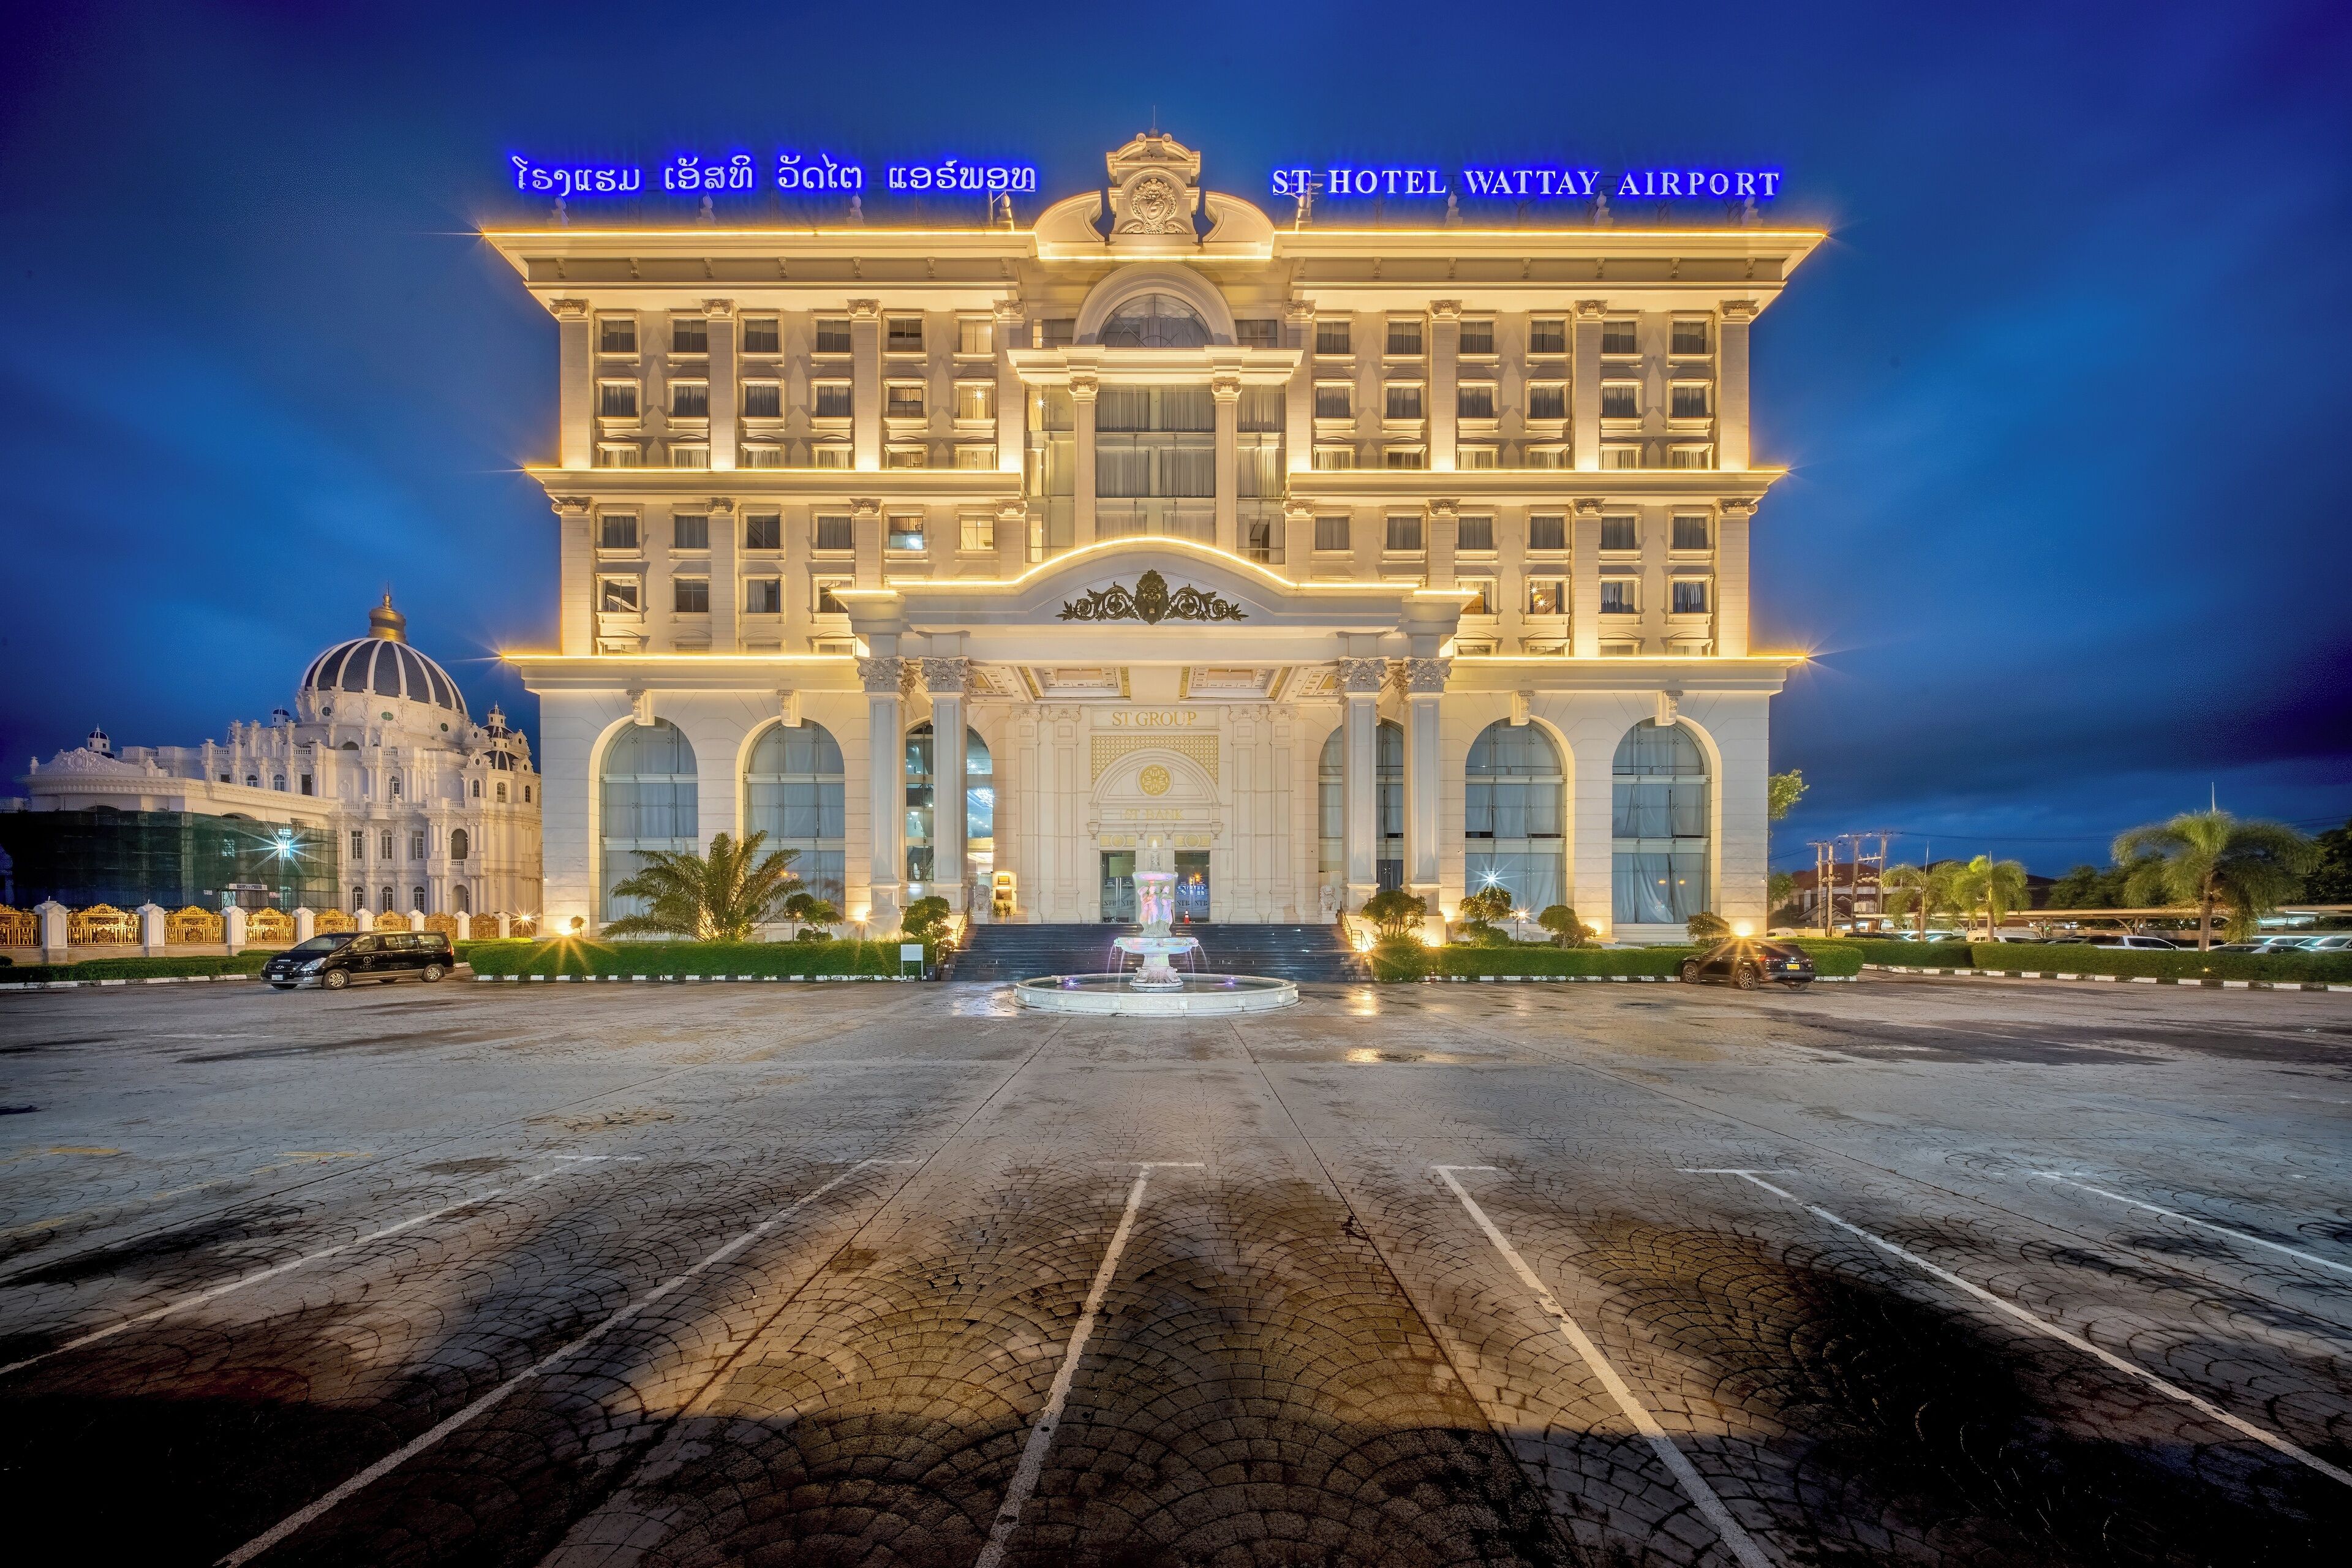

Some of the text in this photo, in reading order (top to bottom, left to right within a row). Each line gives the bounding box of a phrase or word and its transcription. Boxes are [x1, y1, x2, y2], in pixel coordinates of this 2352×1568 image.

[778, 153, 862, 189] ວັດໄຕ
[1273, 170, 1779, 195] ST HOTEL WATTAY AIRPORT
[1112, 711, 1197, 726] ST GROUP
[1146, 809, 1185, 820] BANK
